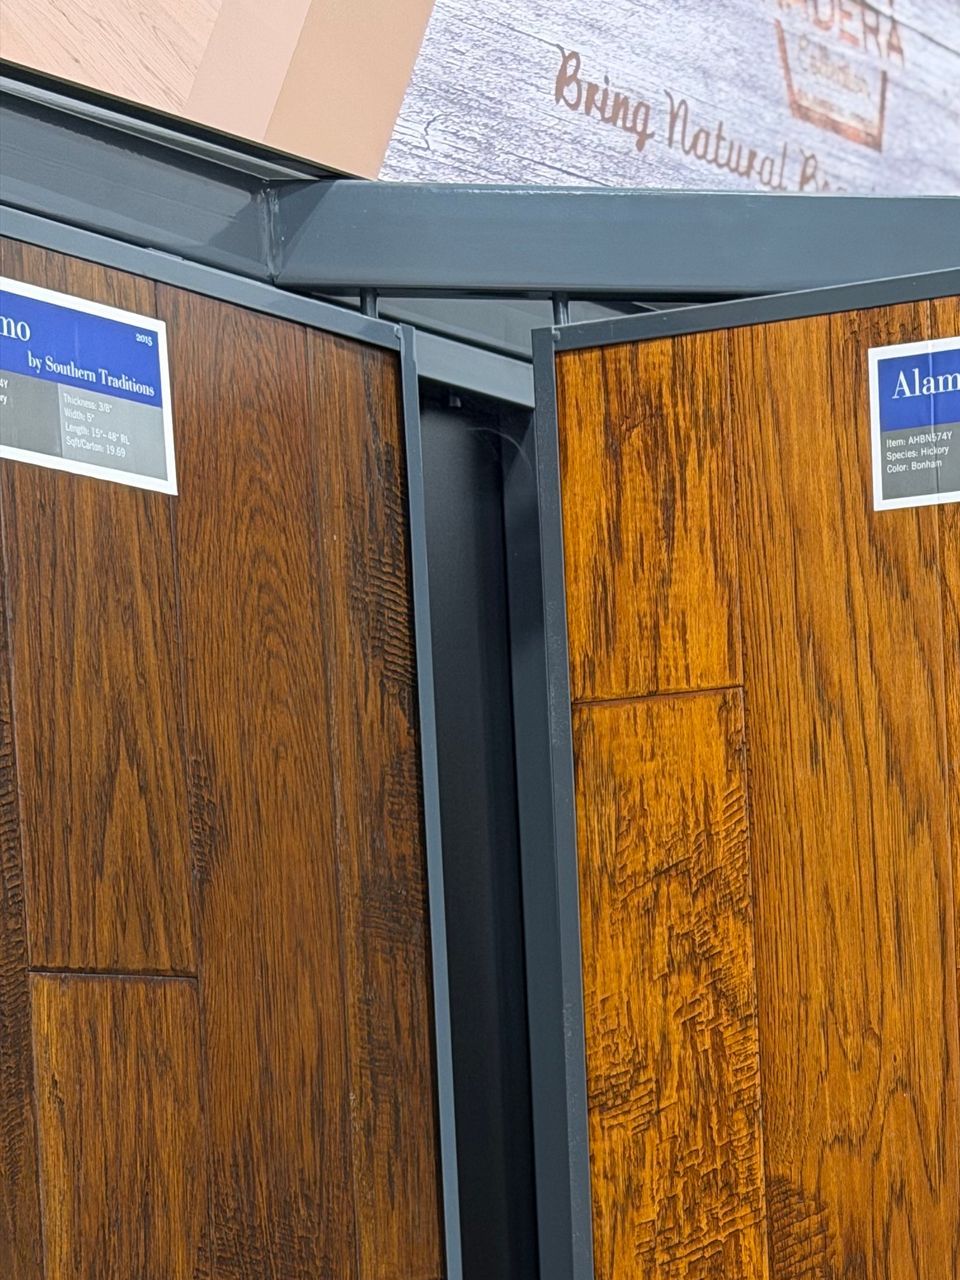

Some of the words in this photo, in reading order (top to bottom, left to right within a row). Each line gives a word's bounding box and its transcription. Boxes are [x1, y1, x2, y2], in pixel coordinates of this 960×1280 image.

[554, 43, 655, 152] Bring
[664, 88, 788, 191] Natural
[135, 332, 153, 346] 2015
[28, 350, 42, 374] by
[45, 356, 96, 383] Southern
[98, 368, 155, 397] Traditions
[63, 392, 97, 410] Thickness:
[64, 407, 86, 421] Width:
[65, 421, 90, 436] Length:
[886, 438, 906, 448] Item:
[886, 449, 918, 461] Species:
[920, 446, 950, 457] Hickory
[886, 462, 909, 473] Color:
[911, 459, 942, 471] Bonham
